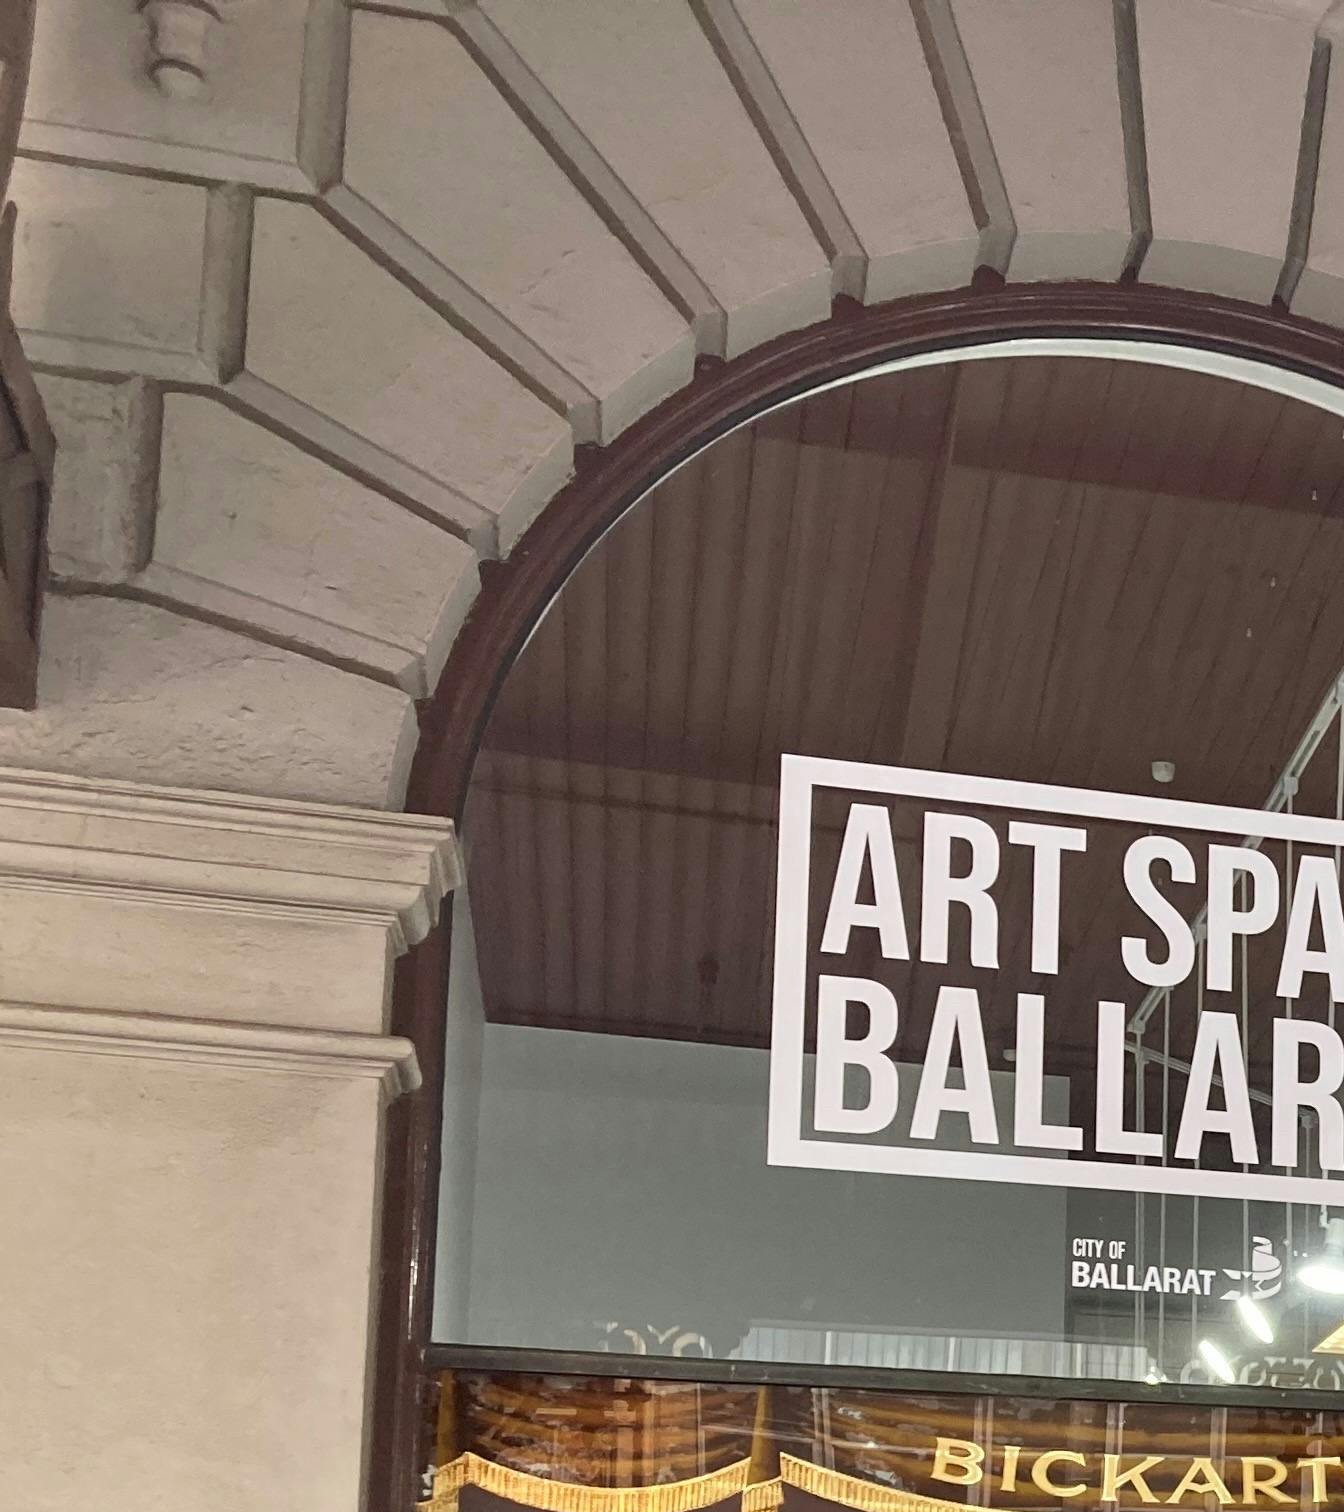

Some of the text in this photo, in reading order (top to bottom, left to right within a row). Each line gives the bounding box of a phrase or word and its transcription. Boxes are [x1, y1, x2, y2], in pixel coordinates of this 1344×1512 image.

[820, 802, 1088, 975] ART
[1072, 1237, 1127, 1260] CITY OF
[1071, 1260, 1216, 1296] BALLARAT
